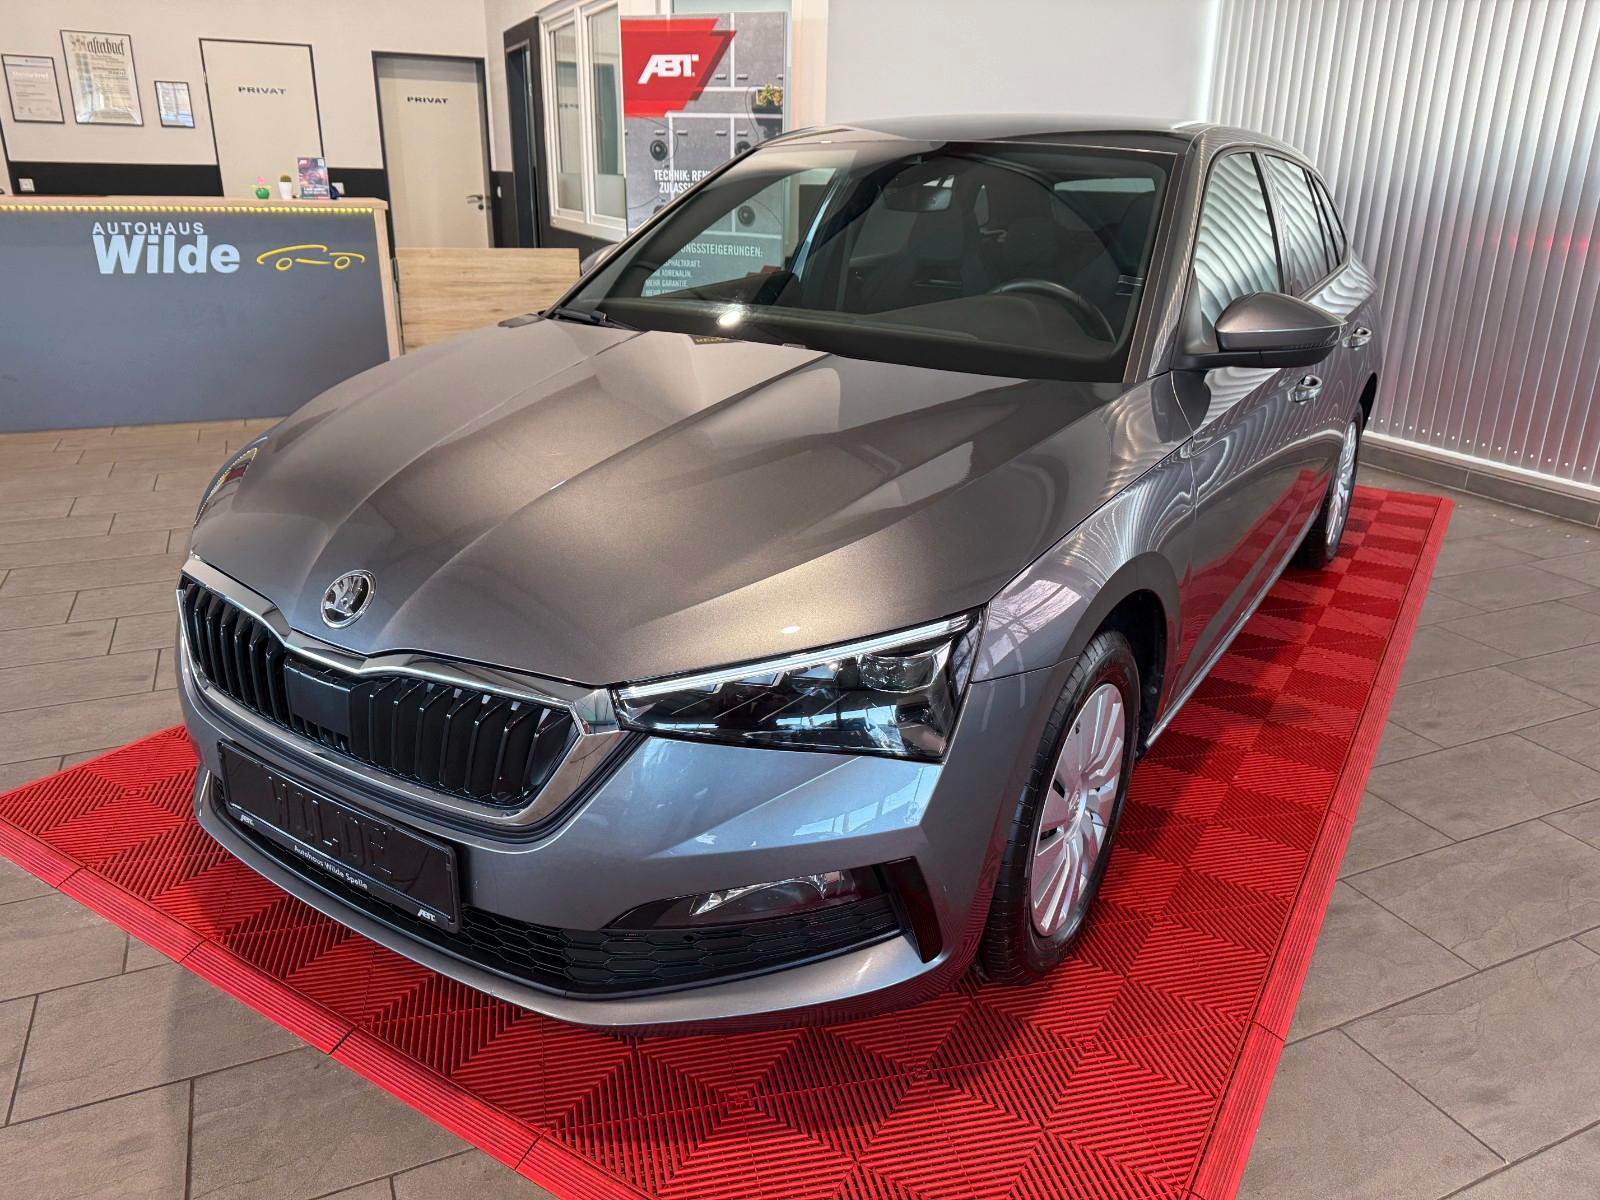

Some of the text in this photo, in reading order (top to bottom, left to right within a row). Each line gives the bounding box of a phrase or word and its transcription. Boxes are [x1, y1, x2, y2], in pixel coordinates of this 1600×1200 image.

[637, 54, 700, 84] ABT
[238, 86, 287, 96] PRIVAT
[407, 96, 448, 105] PRIVAT
[654, 169, 690, 181] TECHNIK:
[659, 182, 694, 194] ZULASS
[92, 222, 204, 235] AUTOHAUS
[92, 234, 241, 275] Wilde
[294, 844, 368, 890] Autohaus Wilde Spelle
